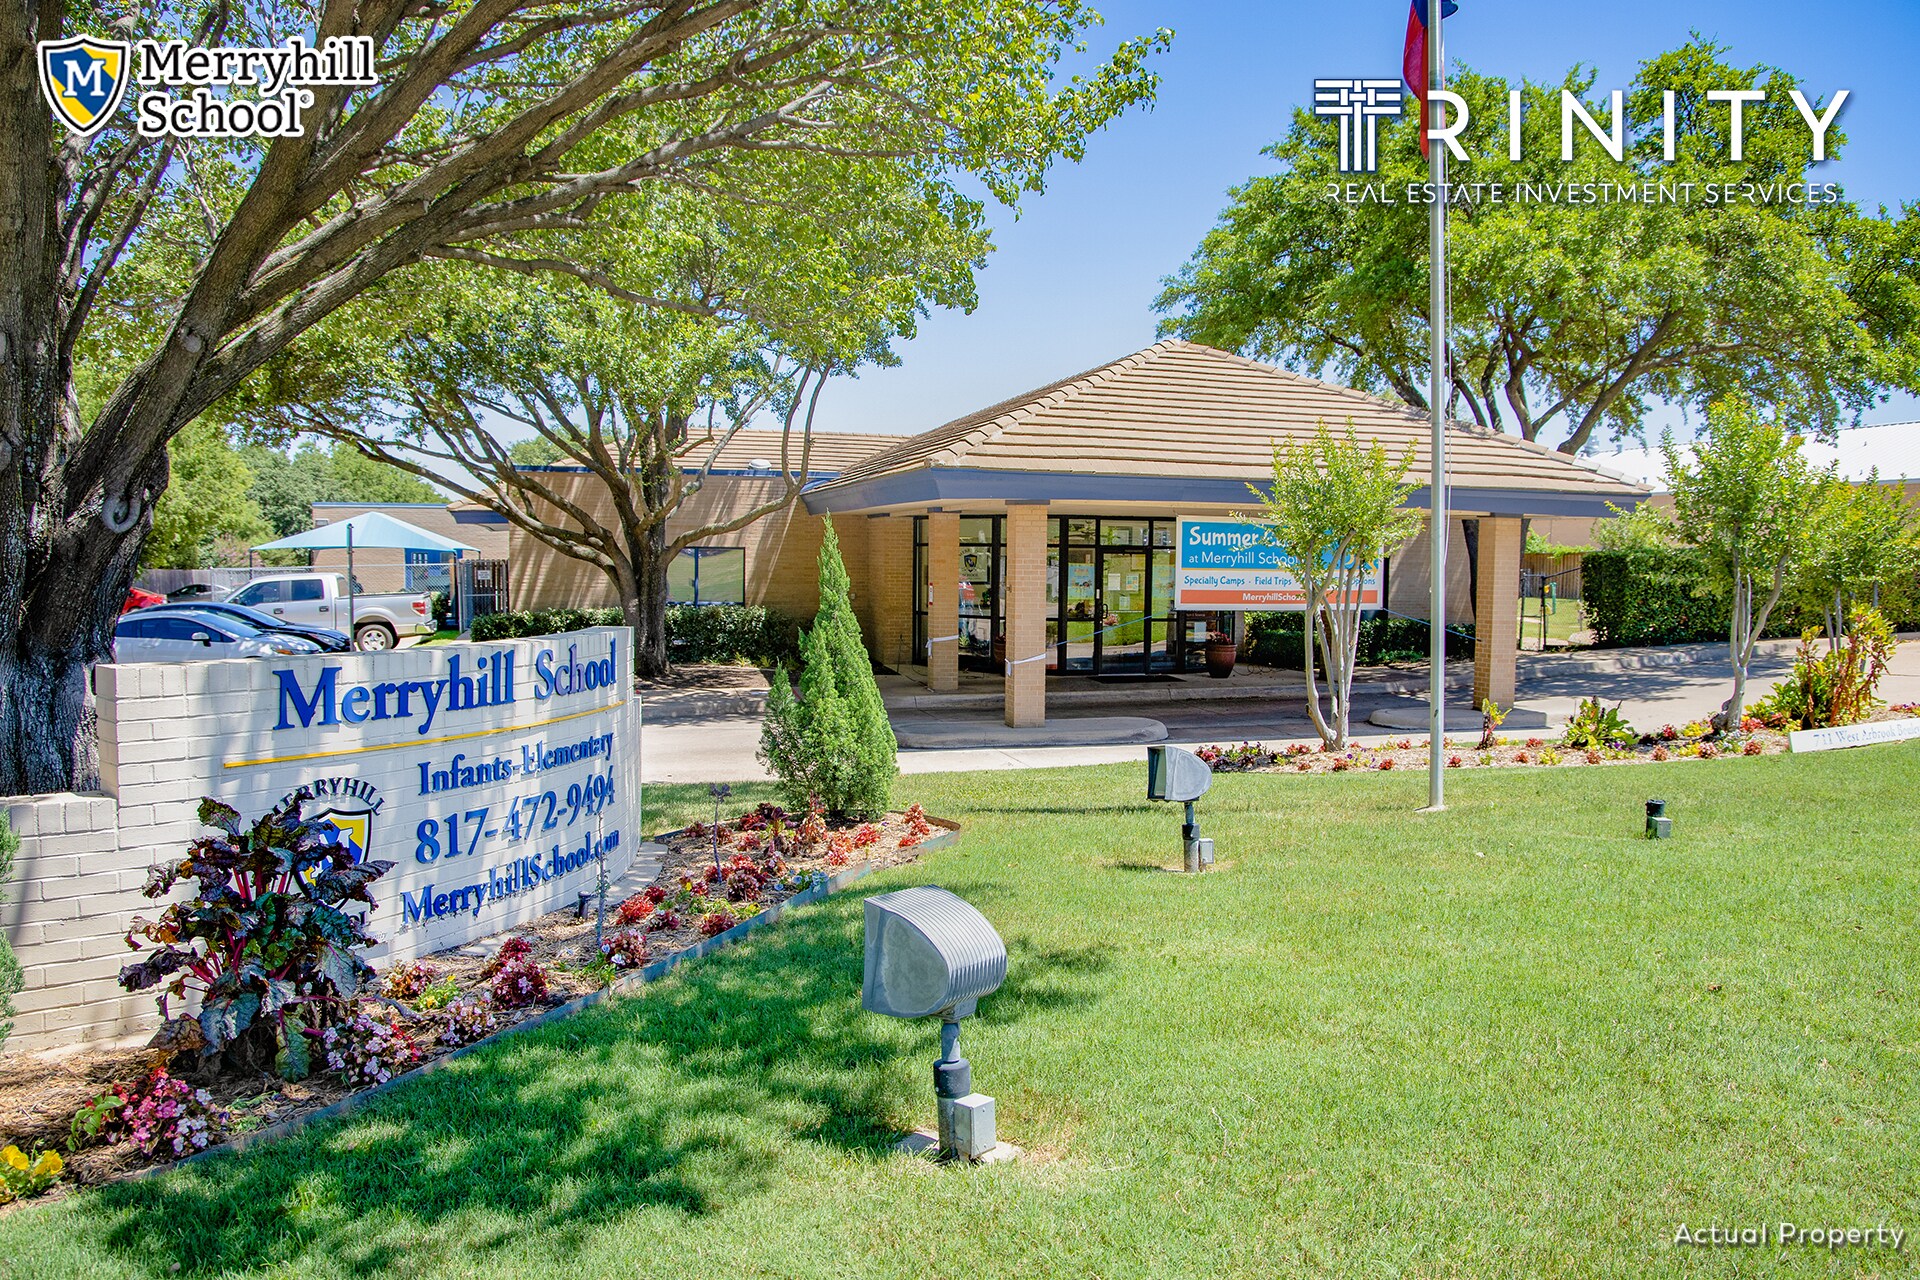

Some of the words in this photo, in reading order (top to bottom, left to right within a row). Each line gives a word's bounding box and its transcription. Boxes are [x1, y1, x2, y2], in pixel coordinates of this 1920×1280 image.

[1189, 526, 1259, 547] Summer
[1189, 553, 1198, 563] at
[1201, 551, 1254, 567] Merryhill
[1184, 575, 1218, 588] Specialty
[1220, 576, 1245, 587] Camps
[1254, 576, 1272, 586] Field
[1274, 577, 1292, 588] Trips
[272, 648, 517, 735] Merryhill
[535, 638, 617, 701] School
[1835, 730, 1859, 743] West
[417, 732, 614, 796] Infants-Elementary
[415, 765, 616, 865] 817-472-9494
